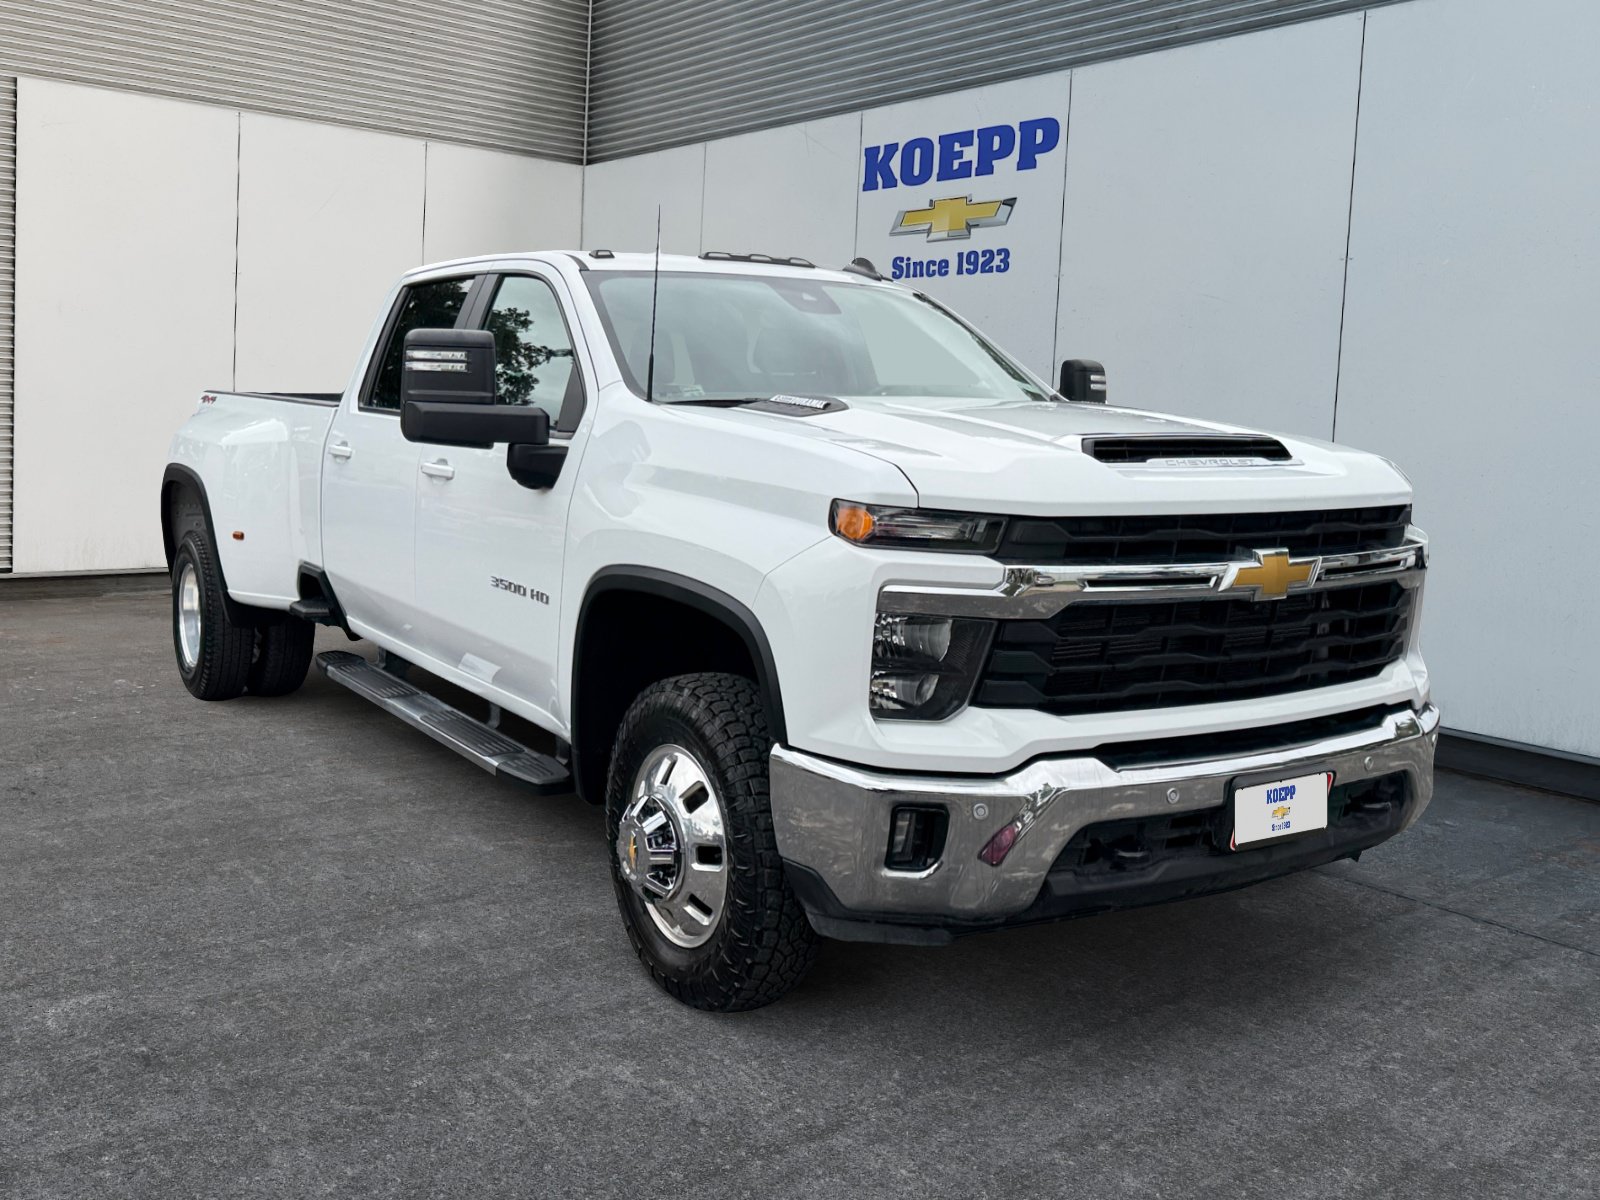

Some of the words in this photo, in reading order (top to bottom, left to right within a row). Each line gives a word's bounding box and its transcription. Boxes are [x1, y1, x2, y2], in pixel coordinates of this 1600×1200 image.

[862, 117, 1060, 192] KOEPP
[892, 256, 949, 280] Since
[956, 248, 1011, 275] 1923
[1165, 459, 1255, 467] CHEVROLET
[490, 575, 527, 597] 3500
[530, 588, 550, 605] HD
[1266, 785, 1296, 804] KOEPP
